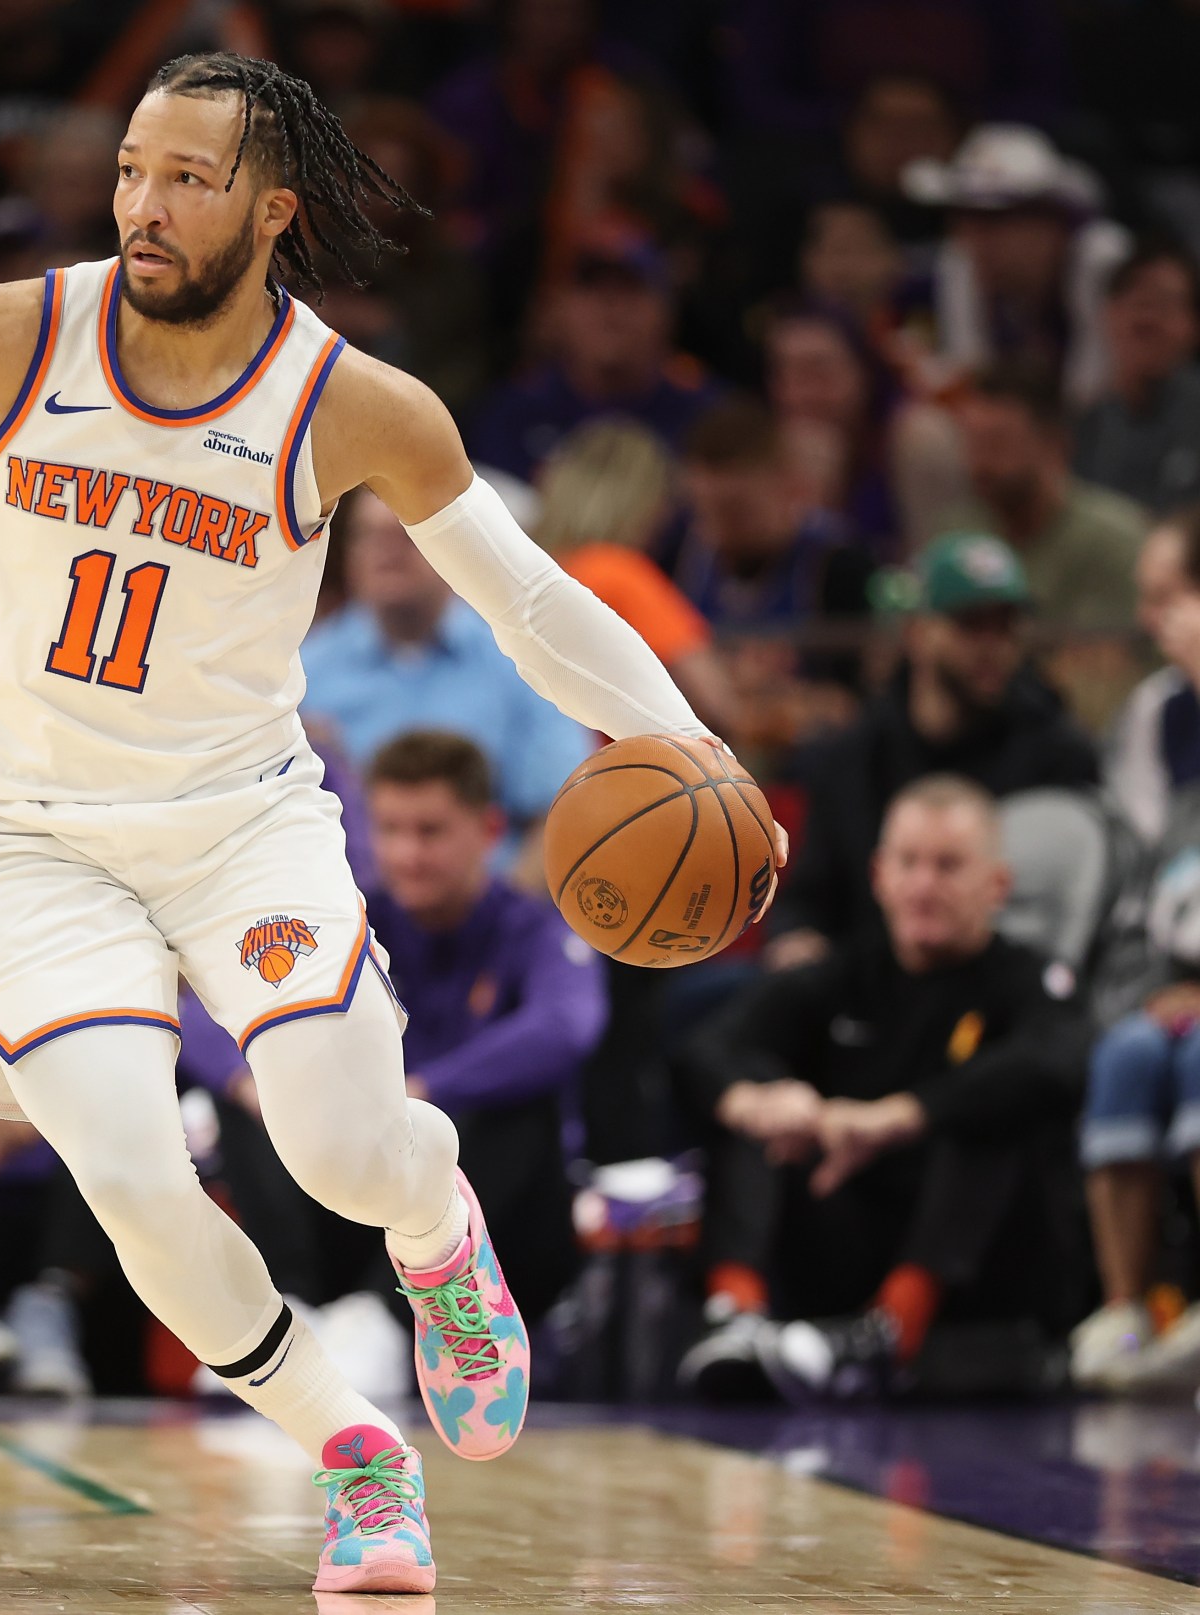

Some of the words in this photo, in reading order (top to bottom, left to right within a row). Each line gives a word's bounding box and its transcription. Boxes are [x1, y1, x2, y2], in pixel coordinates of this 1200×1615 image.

[203, 438, 231, 454] abu
[233, 445, 274, 466] dhabi
[208, 429, 246, 444] experience
[5, 453, 129, 531] NEW
[130, 475, 271, 569] YORK
[44, 549, 170, 694] 11
[255, 916, 270, 928] NEW
[271, 914, 290, 923] YORK
[240, 918, 318, 968] KNICKS
